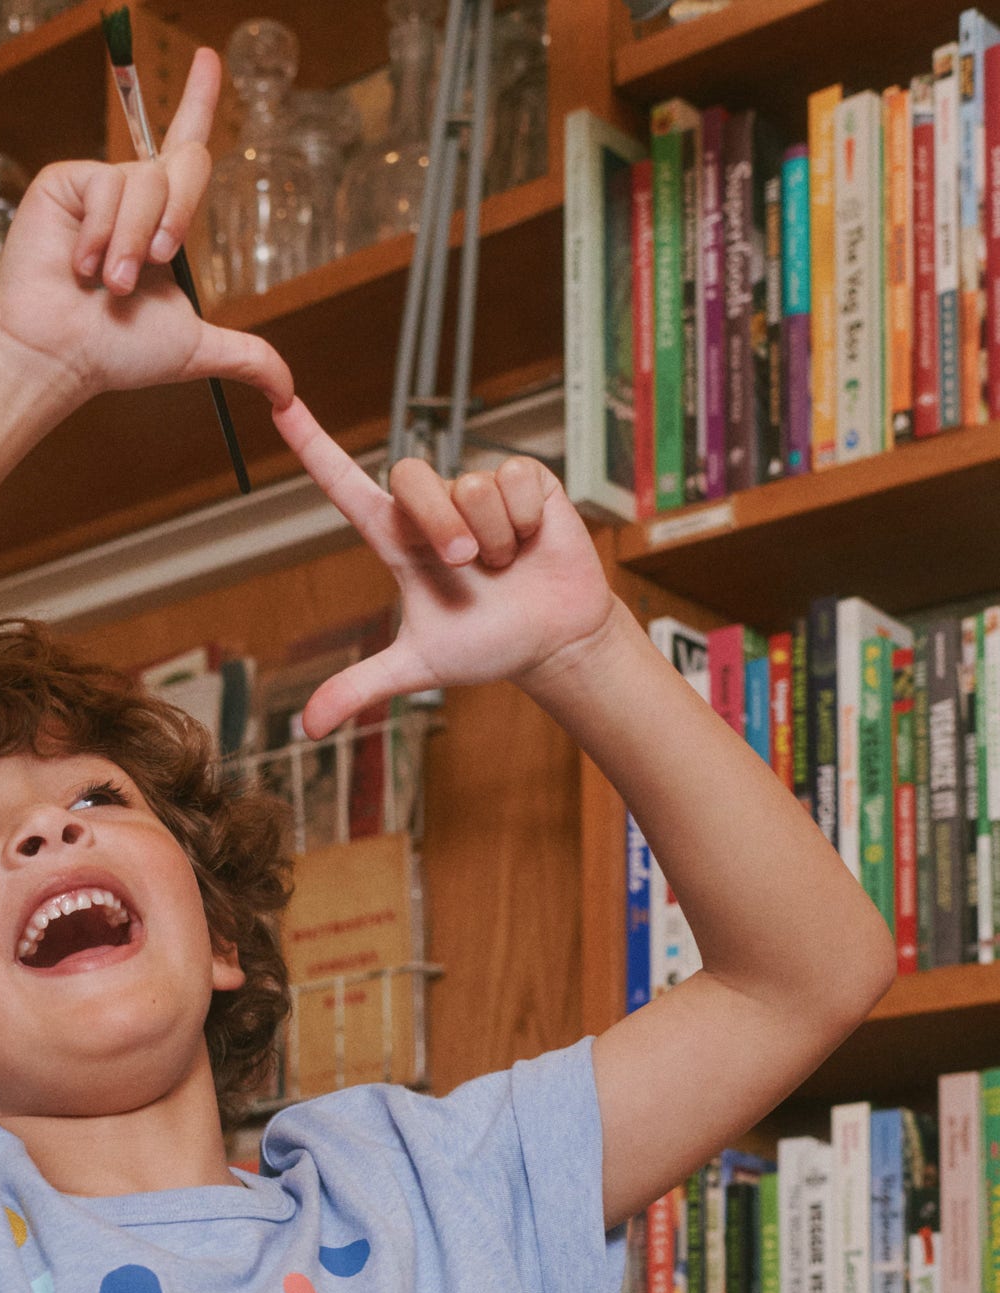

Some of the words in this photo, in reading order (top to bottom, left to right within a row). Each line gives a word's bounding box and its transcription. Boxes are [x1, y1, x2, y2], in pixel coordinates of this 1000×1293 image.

[846, 223, 864, 265] The
[840, 267, 863, 315] Veg
[845, 318, 864, 362] Box
[808, 1200, 826, 1264] VEGGIE
